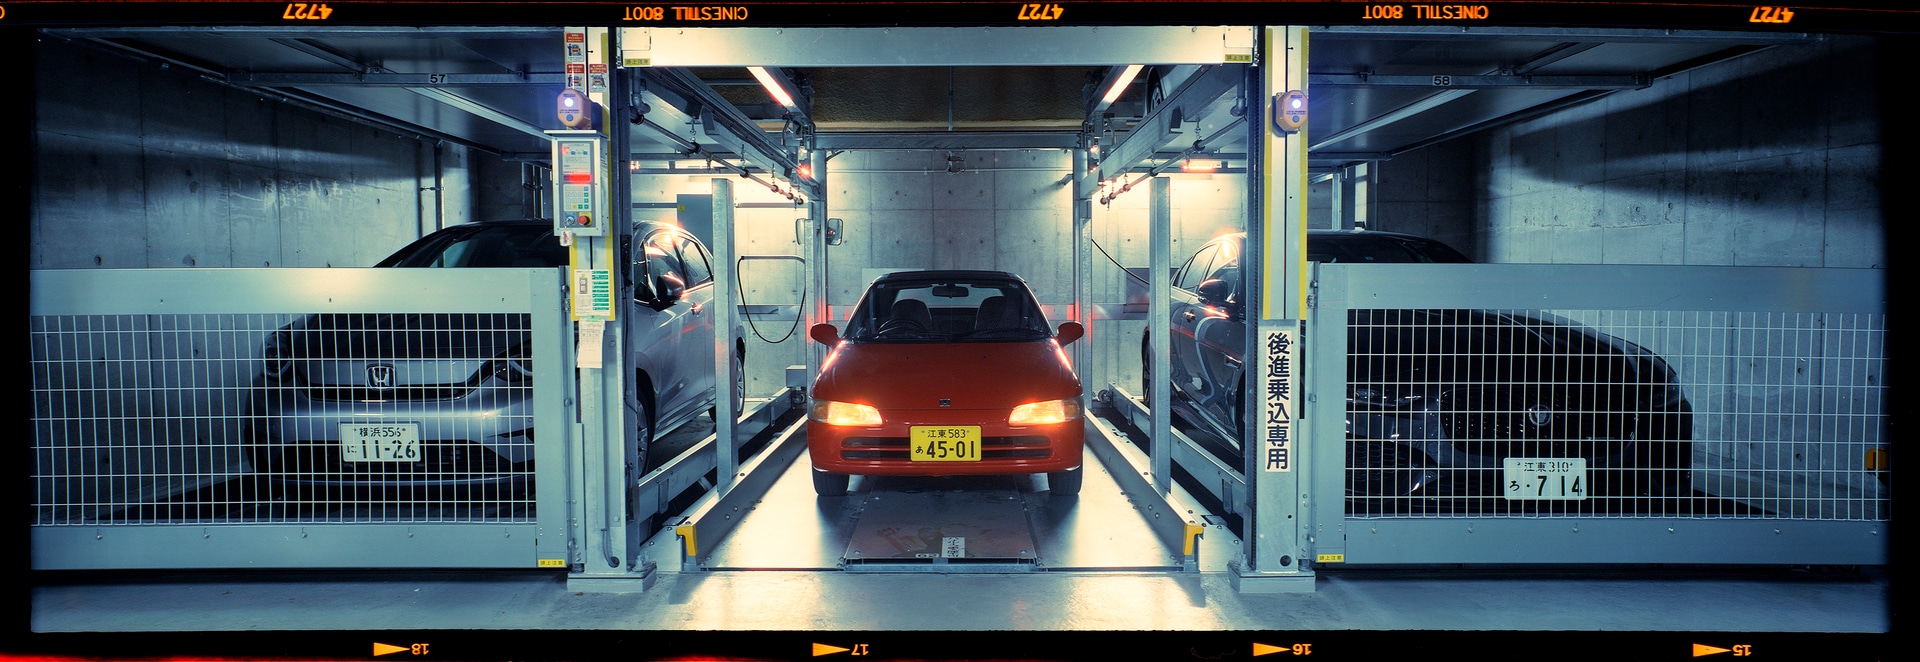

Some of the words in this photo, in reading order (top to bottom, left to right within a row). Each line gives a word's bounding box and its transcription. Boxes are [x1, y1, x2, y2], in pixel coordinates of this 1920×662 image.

[282, 4, 333, 20] 4727
[622, 6, 665, 21] 800T
[671, 6, 749, 21] CINESTILL
[1017, 4, 1064, 20] 4727
[1362, 5, 1404, 20] 800T
[1411, 5, 1489, 20] CINESTILL
[1748, 6, 1794, 24] 4727
[430, 74, 446, 83] 57
[1434, 76, 1450, 85] 58
[1266, 332, 1290, 470] 後進乗込専用
[361, 439, 416, 459] 11-26
[915, 445, 924, 454] あ
[926, 440, 974, 458] 45-01
[1509, 480, 1520, 491] ろ
[412, 643, 430, 656] 18
[852, 643, 869, 656] 17
[1293, 643, 1312, 656] 16
[1732, 644, 1751, 657] 15
